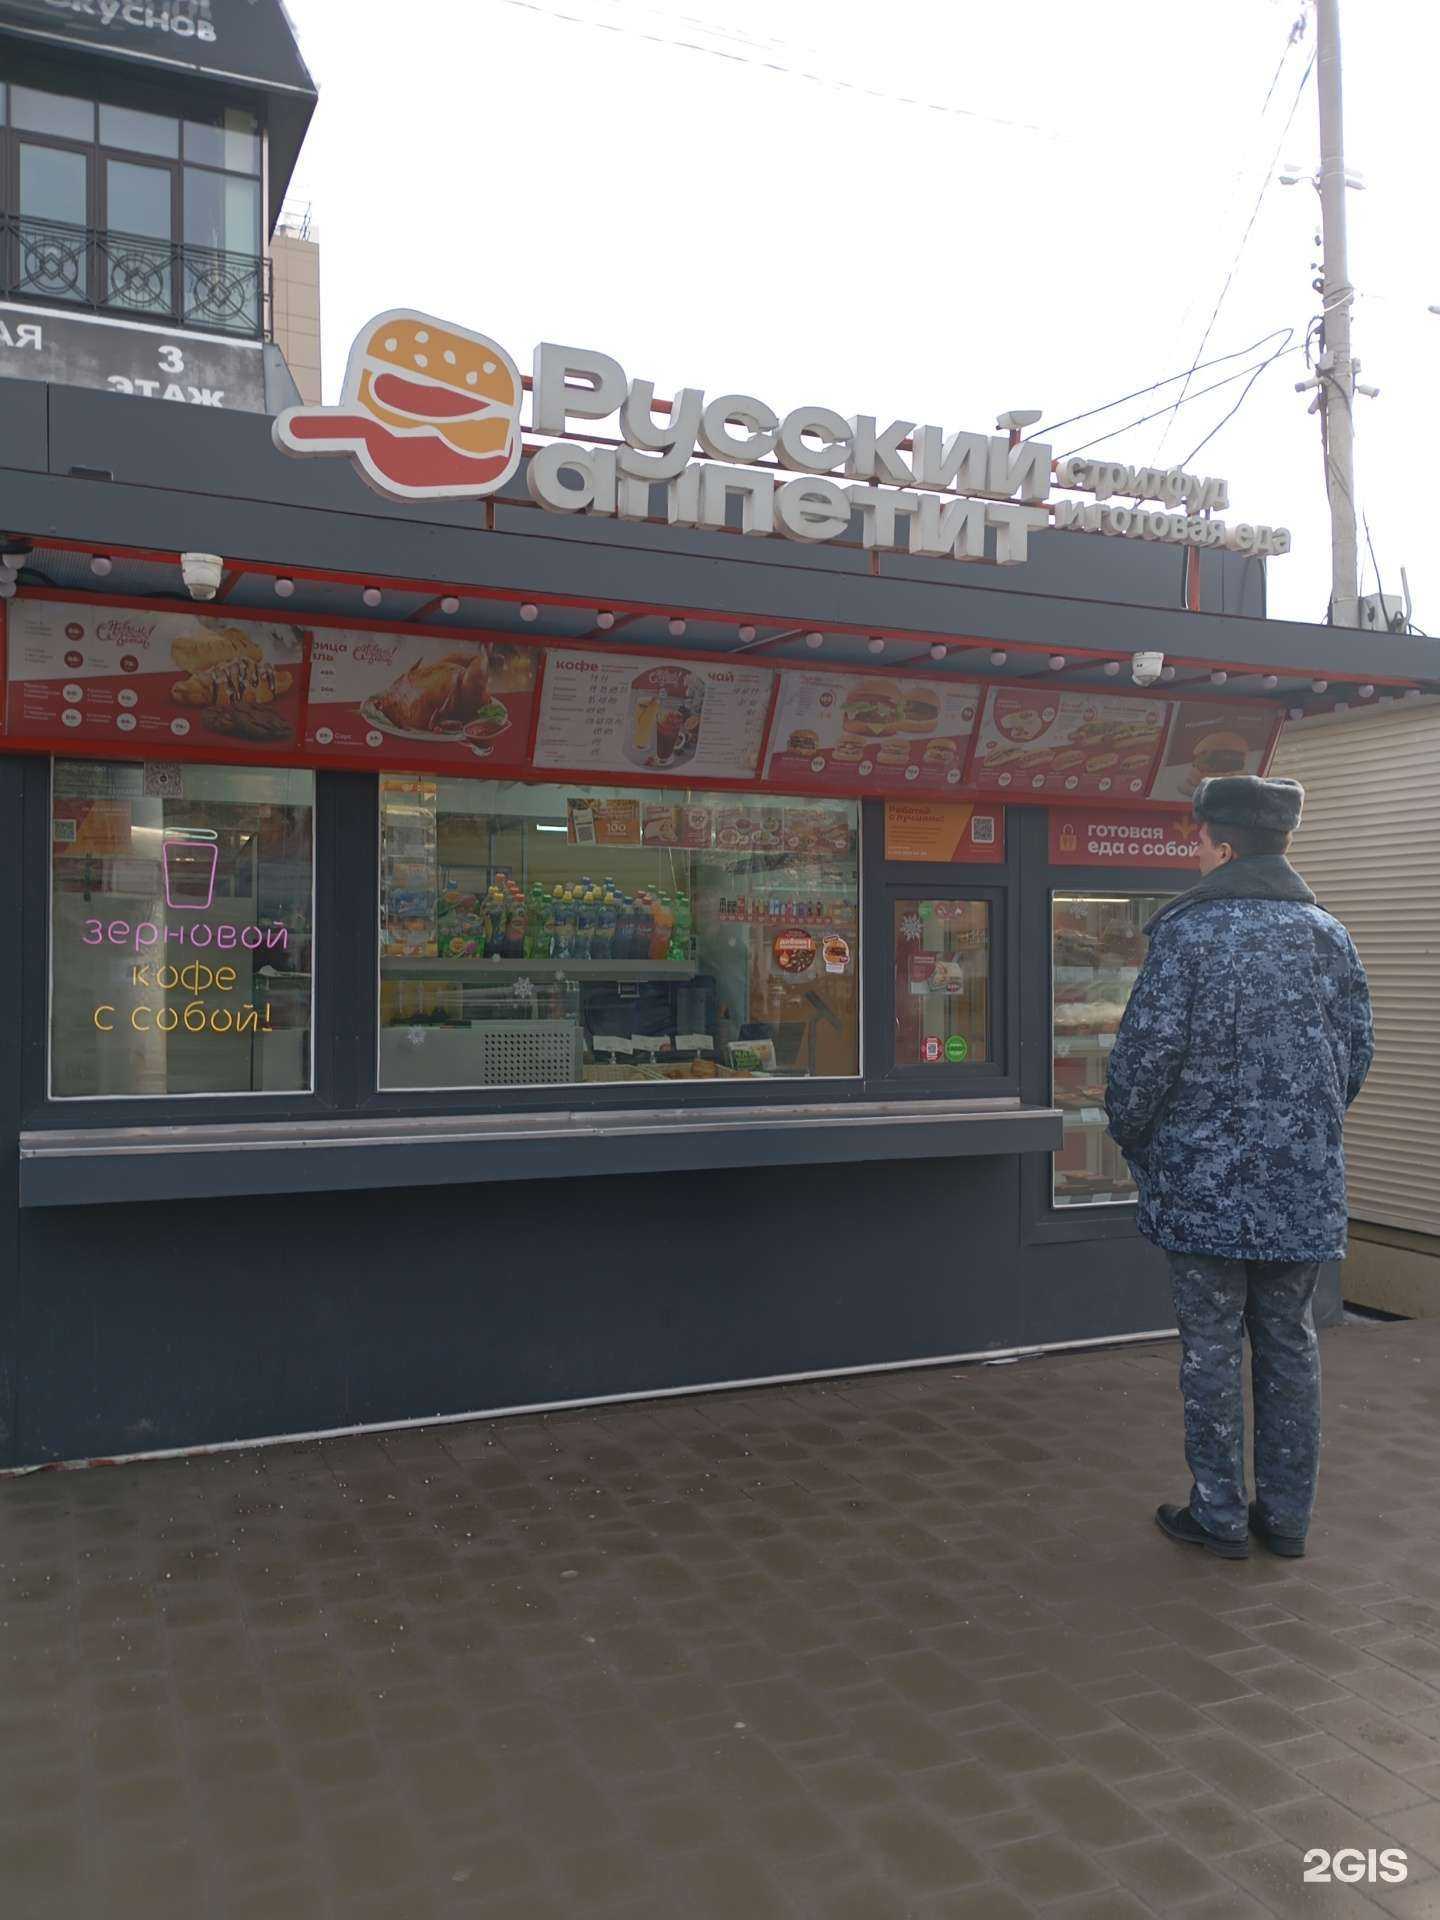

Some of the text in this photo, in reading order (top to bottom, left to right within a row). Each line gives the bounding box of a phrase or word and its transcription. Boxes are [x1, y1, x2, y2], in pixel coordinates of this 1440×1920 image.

[158, 345, 185, 373] 3
[106, 375, 224, 408] ЭТАЖ
[532, 341, 1052, 501] Русский
[1053, 456, 1229, 515] стритфуд
[527, 442, 1049, 565] аппетит
[1050, 499, 1292, 558] и готовая еда
[556, 660, 599, 672] кофе
[707, 671, 735, 683] чай
[1087, 823, 1164, 840] готовая
[1087, 839, 1200, 858] еда с собой
[82, 919, 288, 951] зерновой
[133, 959, 237, 996] кофе
[94, 1001, 272, 1032] с собой!
